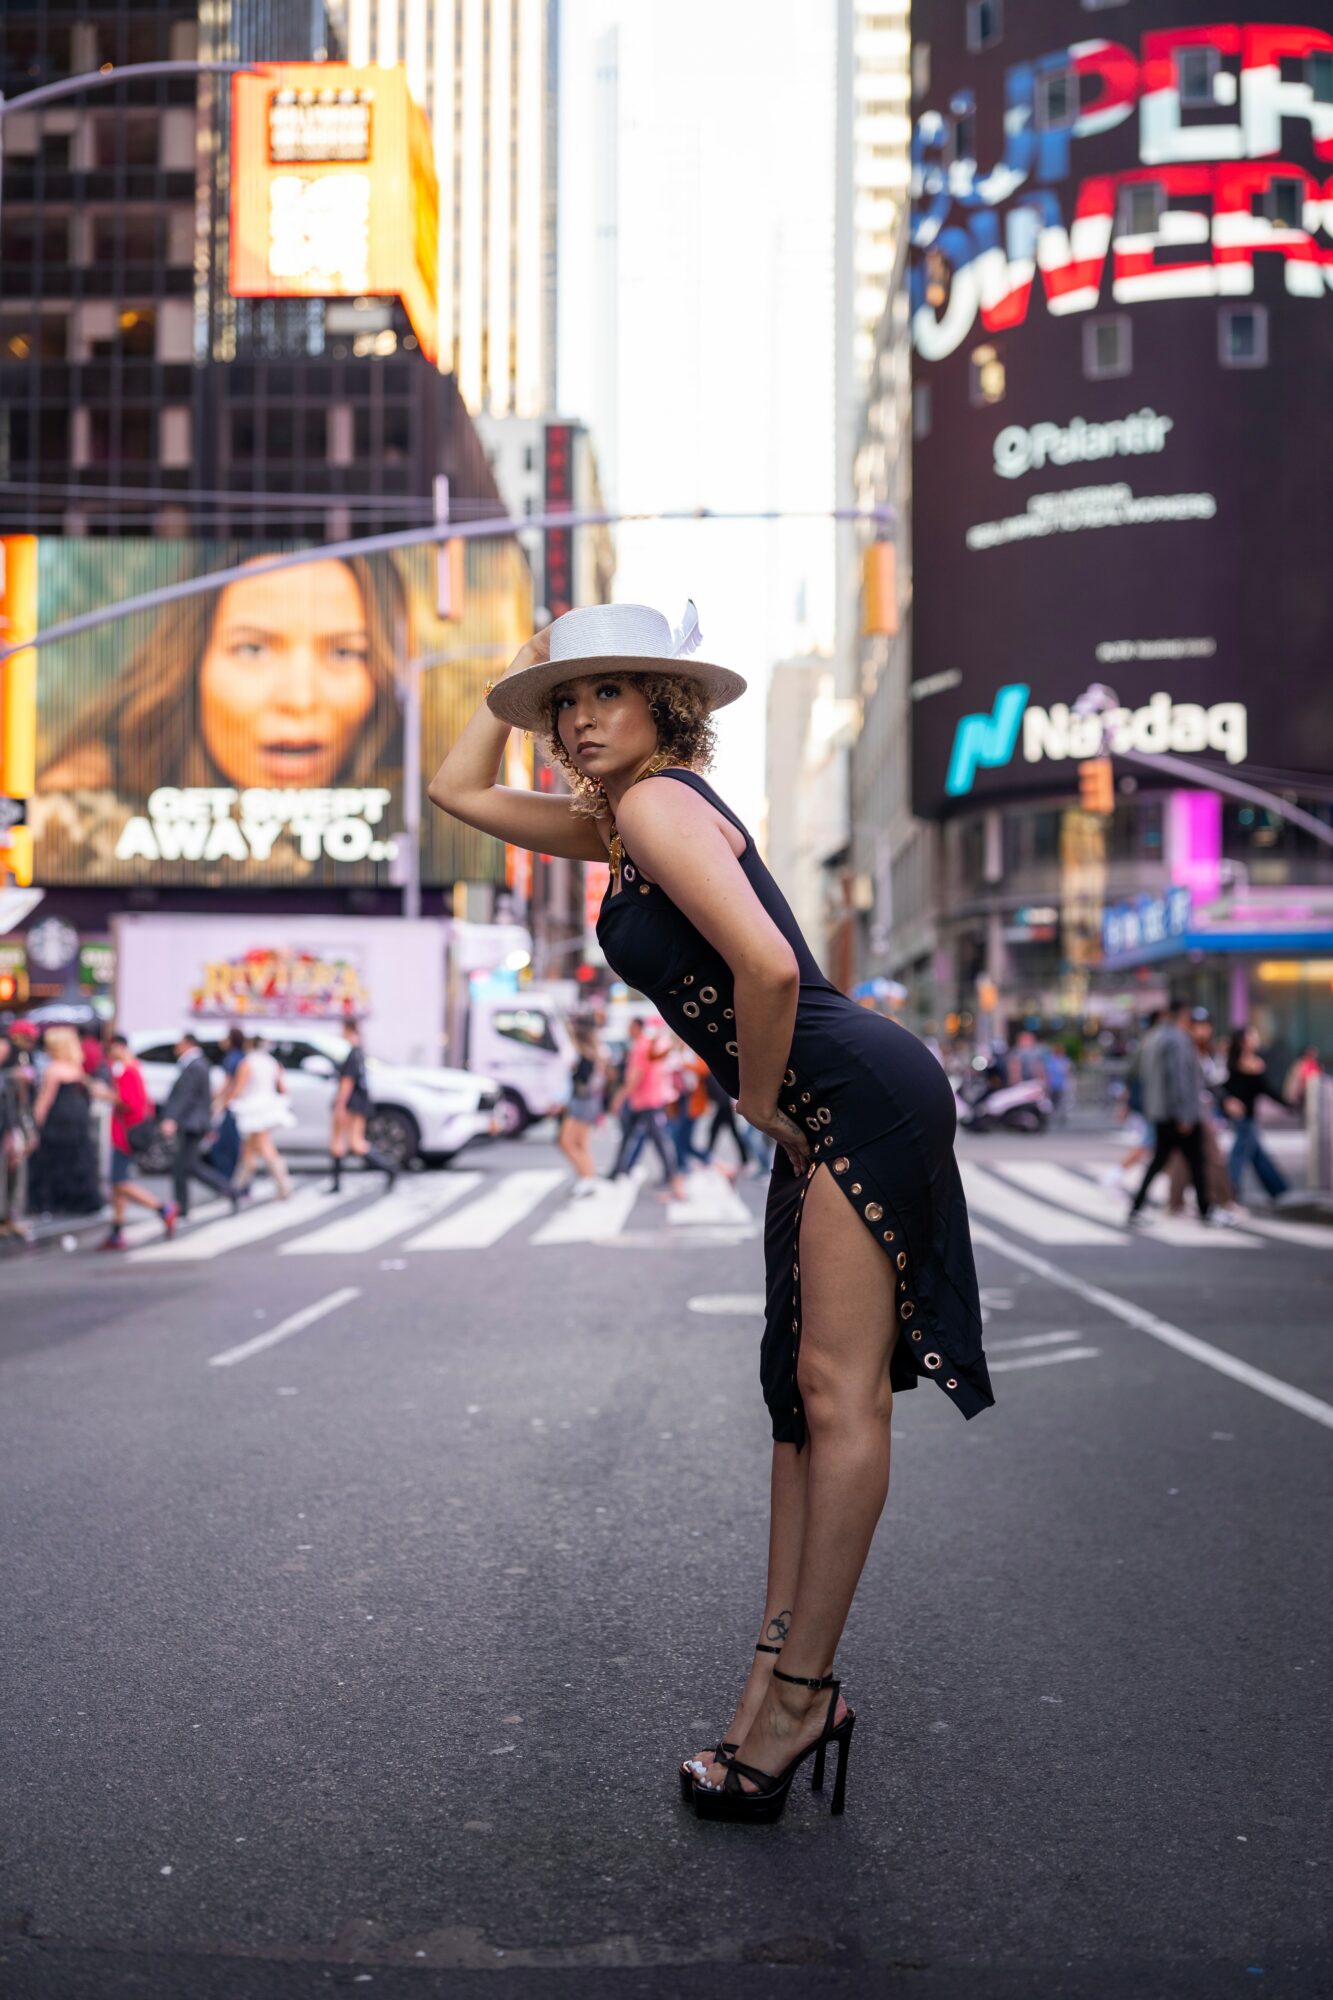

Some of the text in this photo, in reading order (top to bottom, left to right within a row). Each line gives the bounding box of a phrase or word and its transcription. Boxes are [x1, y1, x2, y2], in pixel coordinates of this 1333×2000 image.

[1023, 692, 1247, 764] Nasdaq
[148, 786, 391, 824] GET SWEPT
[115, 816, 284, 861] AWAY
